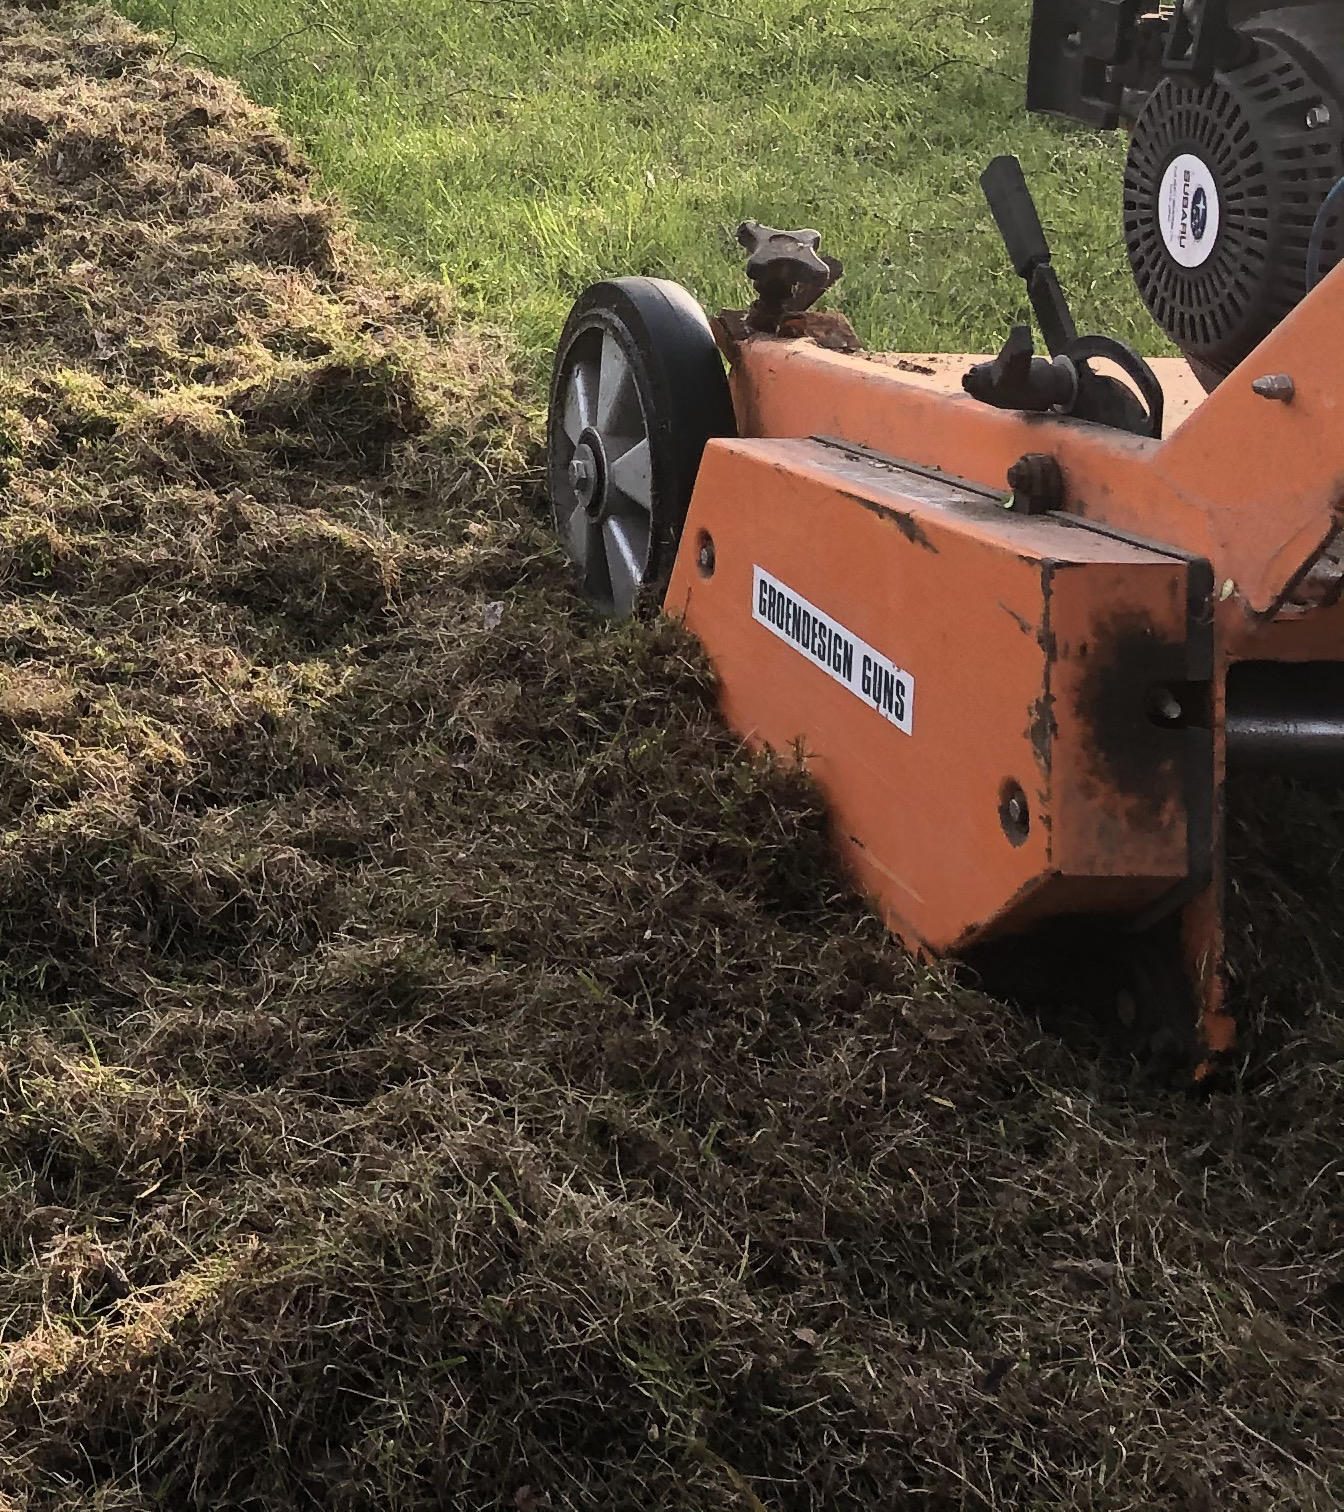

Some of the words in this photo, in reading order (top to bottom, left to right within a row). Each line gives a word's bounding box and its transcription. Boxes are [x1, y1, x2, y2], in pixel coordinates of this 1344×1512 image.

[1179, 169, 1191, 249] SUBARU
[758, 578, 854, 683] GROENDESIGN
[861, 654, 906, 722] GUNS
